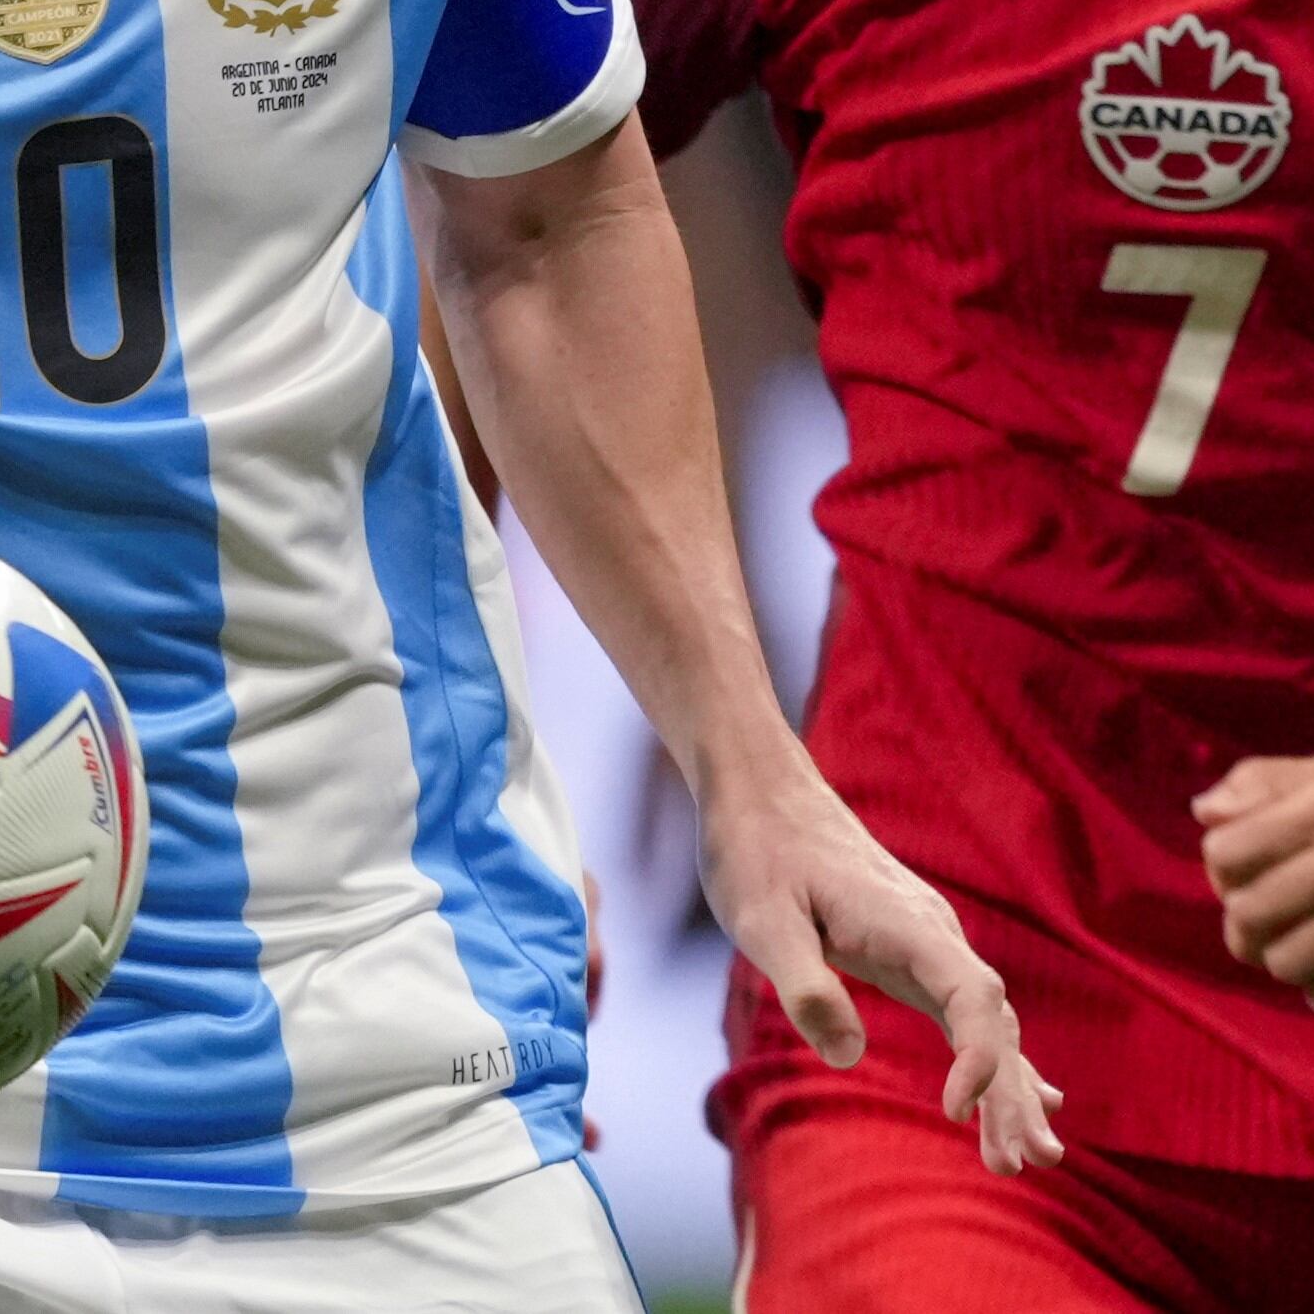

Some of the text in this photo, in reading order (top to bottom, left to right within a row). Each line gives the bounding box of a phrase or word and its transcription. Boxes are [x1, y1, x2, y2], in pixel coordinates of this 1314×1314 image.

[5, 6, 76, 24] CAMPEÓN
[27, 28, 60, 43] 2021
[221, 60, 280, 80] ARGENTINA
[295, 52, 338, 72] CANADA
[232, 72, 328, 97] 20 DE JUNIO 2024
[257, 93, 305, 113] ATLANTA
[1090, 102, 1278, 139] CANADA
[1100, 242, 1269, 497] 7
